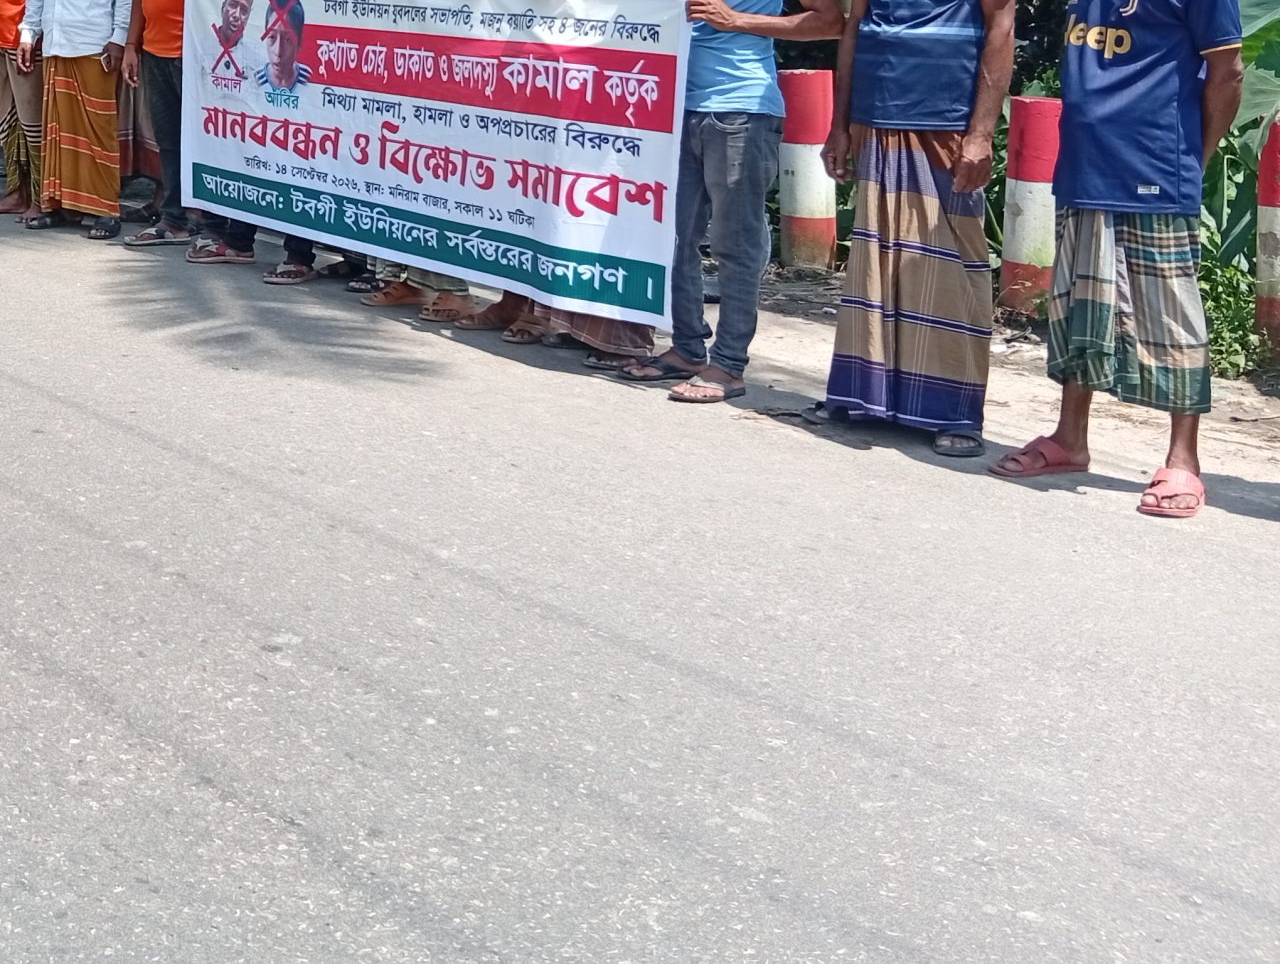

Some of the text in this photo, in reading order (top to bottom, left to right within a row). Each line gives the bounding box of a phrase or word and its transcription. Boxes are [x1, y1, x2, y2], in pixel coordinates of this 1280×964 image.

[393, 4, 427, 25] যুবদলের
[430, 4, 474, 31] সভাপতি,
[480, 12, 505, 33] মজনু
[507, 8, 537, 32] বয়াতি
[539, 15, 557, 35] সহ
[558, 17, 567, 34] ৪
[573, 18, 609, 37] জনের
[611, 14, 661, 44] বিরুদ্ধে
[211, 75, 242, 93] কামাল
[264, 88, 300, 110] আবির
[316, 38, 660, 127] কুখ্যাত চোর, ডাকাত ও জলদস্যু কামাল কর্তৃক
[321, 87, 644, 157] মিথ্যা মামলা, হামলা ও অপপ্রচারের বিরুদ্ধে
[201, 106, 668, 224] মানববন্ধন ও বিক্ষোভ সমাবেশ
[244, 155, 271, 172] তারিখ:
[275, 163, 287, 175] ১৪
[291, 166, 328, 184] সেপ্টেম্বর
[388, 183, 420, 204] মনিরাম
[422, 193, 451, 214] বাজার,
[454, 200, 484, 218] সকাল
[488, 208, 503, 222] ১১
[507, 209, 535, 229] ঘটিকা
[202, 172, 284, 210] আয়োজনে:
[290, 187, 337, 224] টবগী
[343, 198, 438, 249] ইউনিয়নের
[444, 229, 534, 273] সর্বস্তরের
[537, 254, 628, 293] জনগণ
